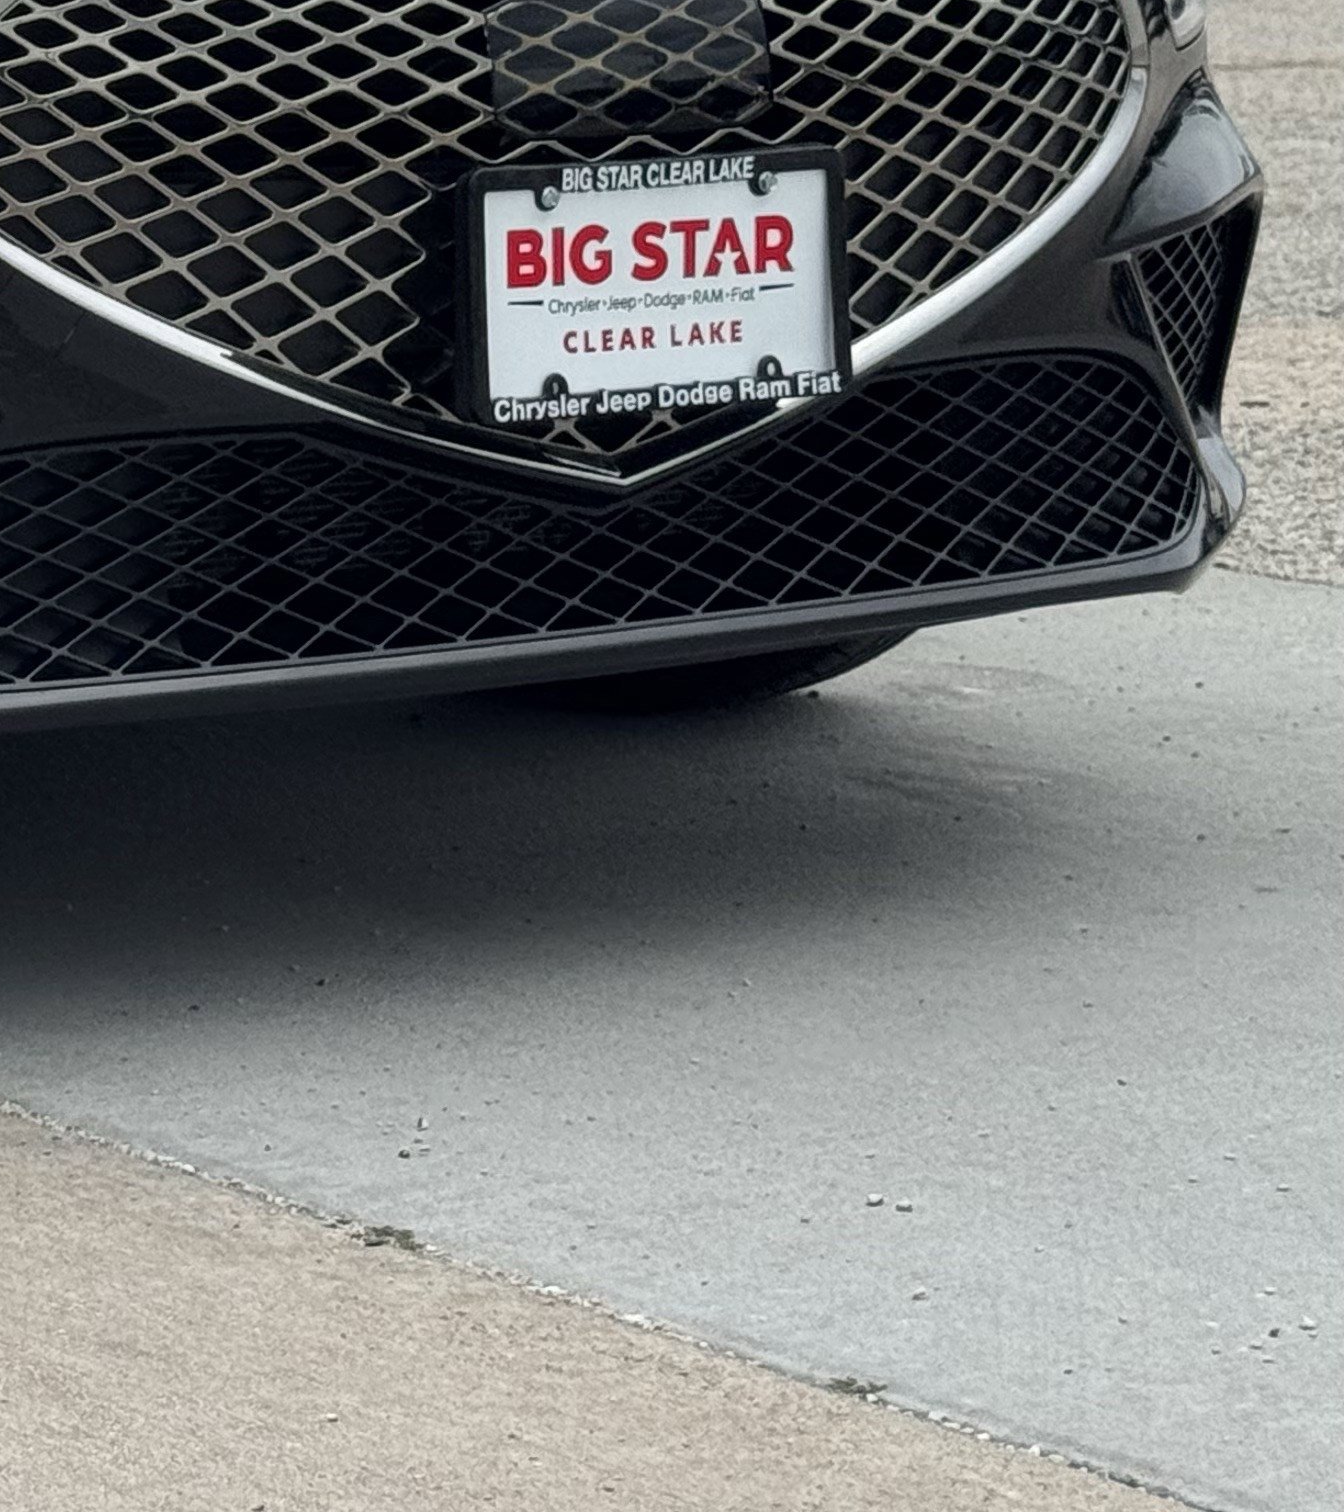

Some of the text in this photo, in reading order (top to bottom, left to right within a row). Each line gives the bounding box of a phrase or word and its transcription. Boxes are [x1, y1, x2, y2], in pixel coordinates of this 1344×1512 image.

[562, 155, 755, 191] BIG STAR CLEAR LAKE
[506, 215, 795, 289] BIG STAR
[548, 286, 755, 316] Chrysler Jeep Dodge RAM Fiat
[563, 319, 744, 354] CLEAR LAKE
[493, 371, 843, 423] Chrysler Jeep Dodge Ram Fiat
